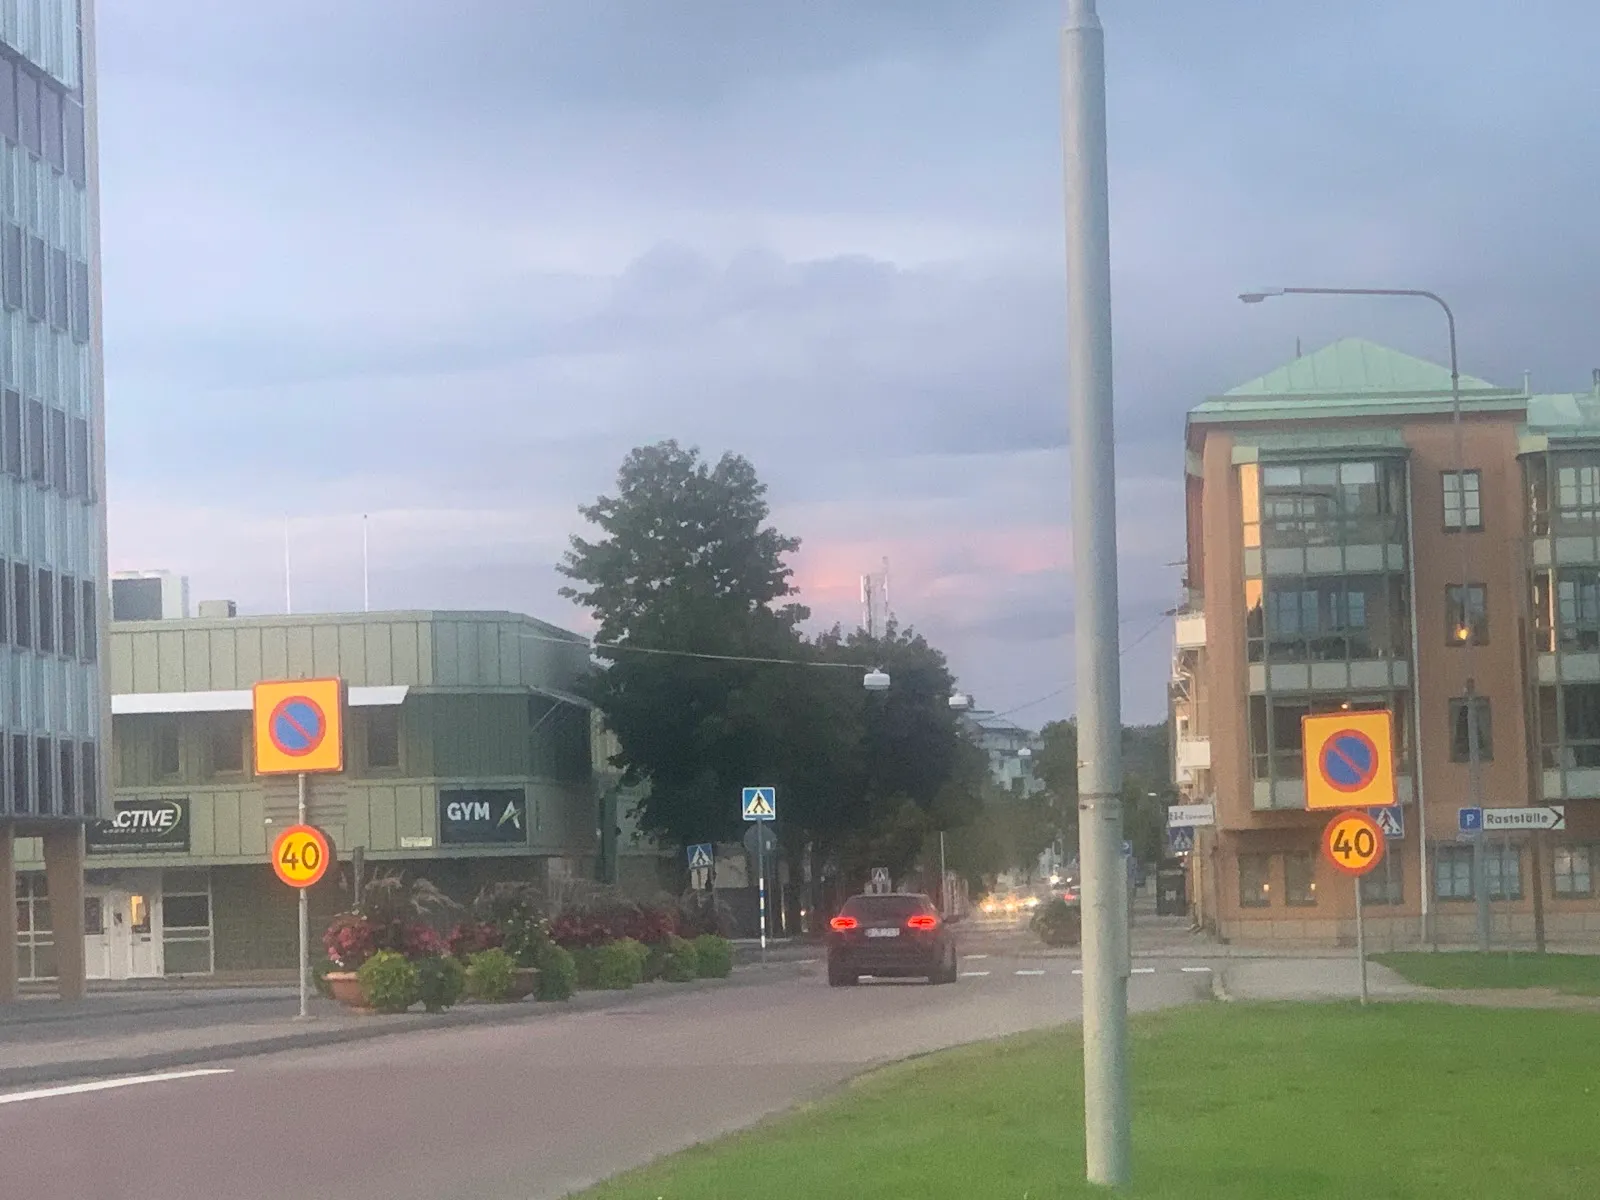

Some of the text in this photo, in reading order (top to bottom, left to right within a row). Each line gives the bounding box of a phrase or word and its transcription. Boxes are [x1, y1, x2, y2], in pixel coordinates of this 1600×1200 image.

[446, 801, 490, 821] GYM
[1466, 813, 1475, 827] P
[281, 841, 320, 871] 40
[1332, 827, 1375, 860] 40
